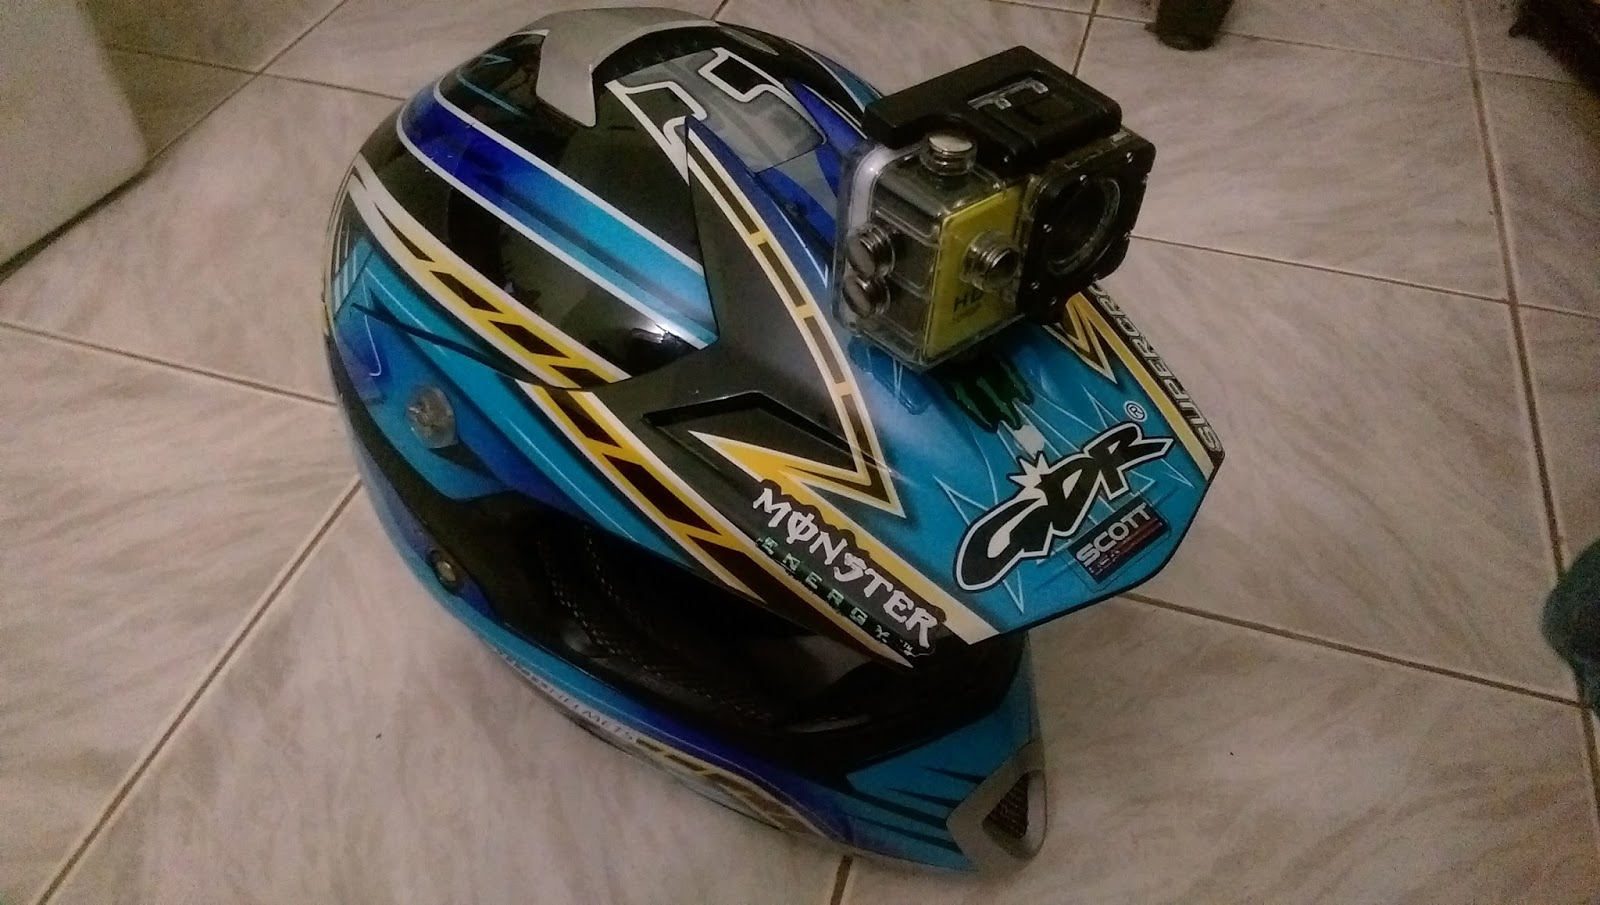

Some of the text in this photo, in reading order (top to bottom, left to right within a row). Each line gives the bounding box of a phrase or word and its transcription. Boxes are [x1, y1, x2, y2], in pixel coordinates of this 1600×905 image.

[752, 487, 938, 649] MONSTER
[1075, 501, 1151, 568] SCOTT
[760, 536, 891, 643] ENERGY
